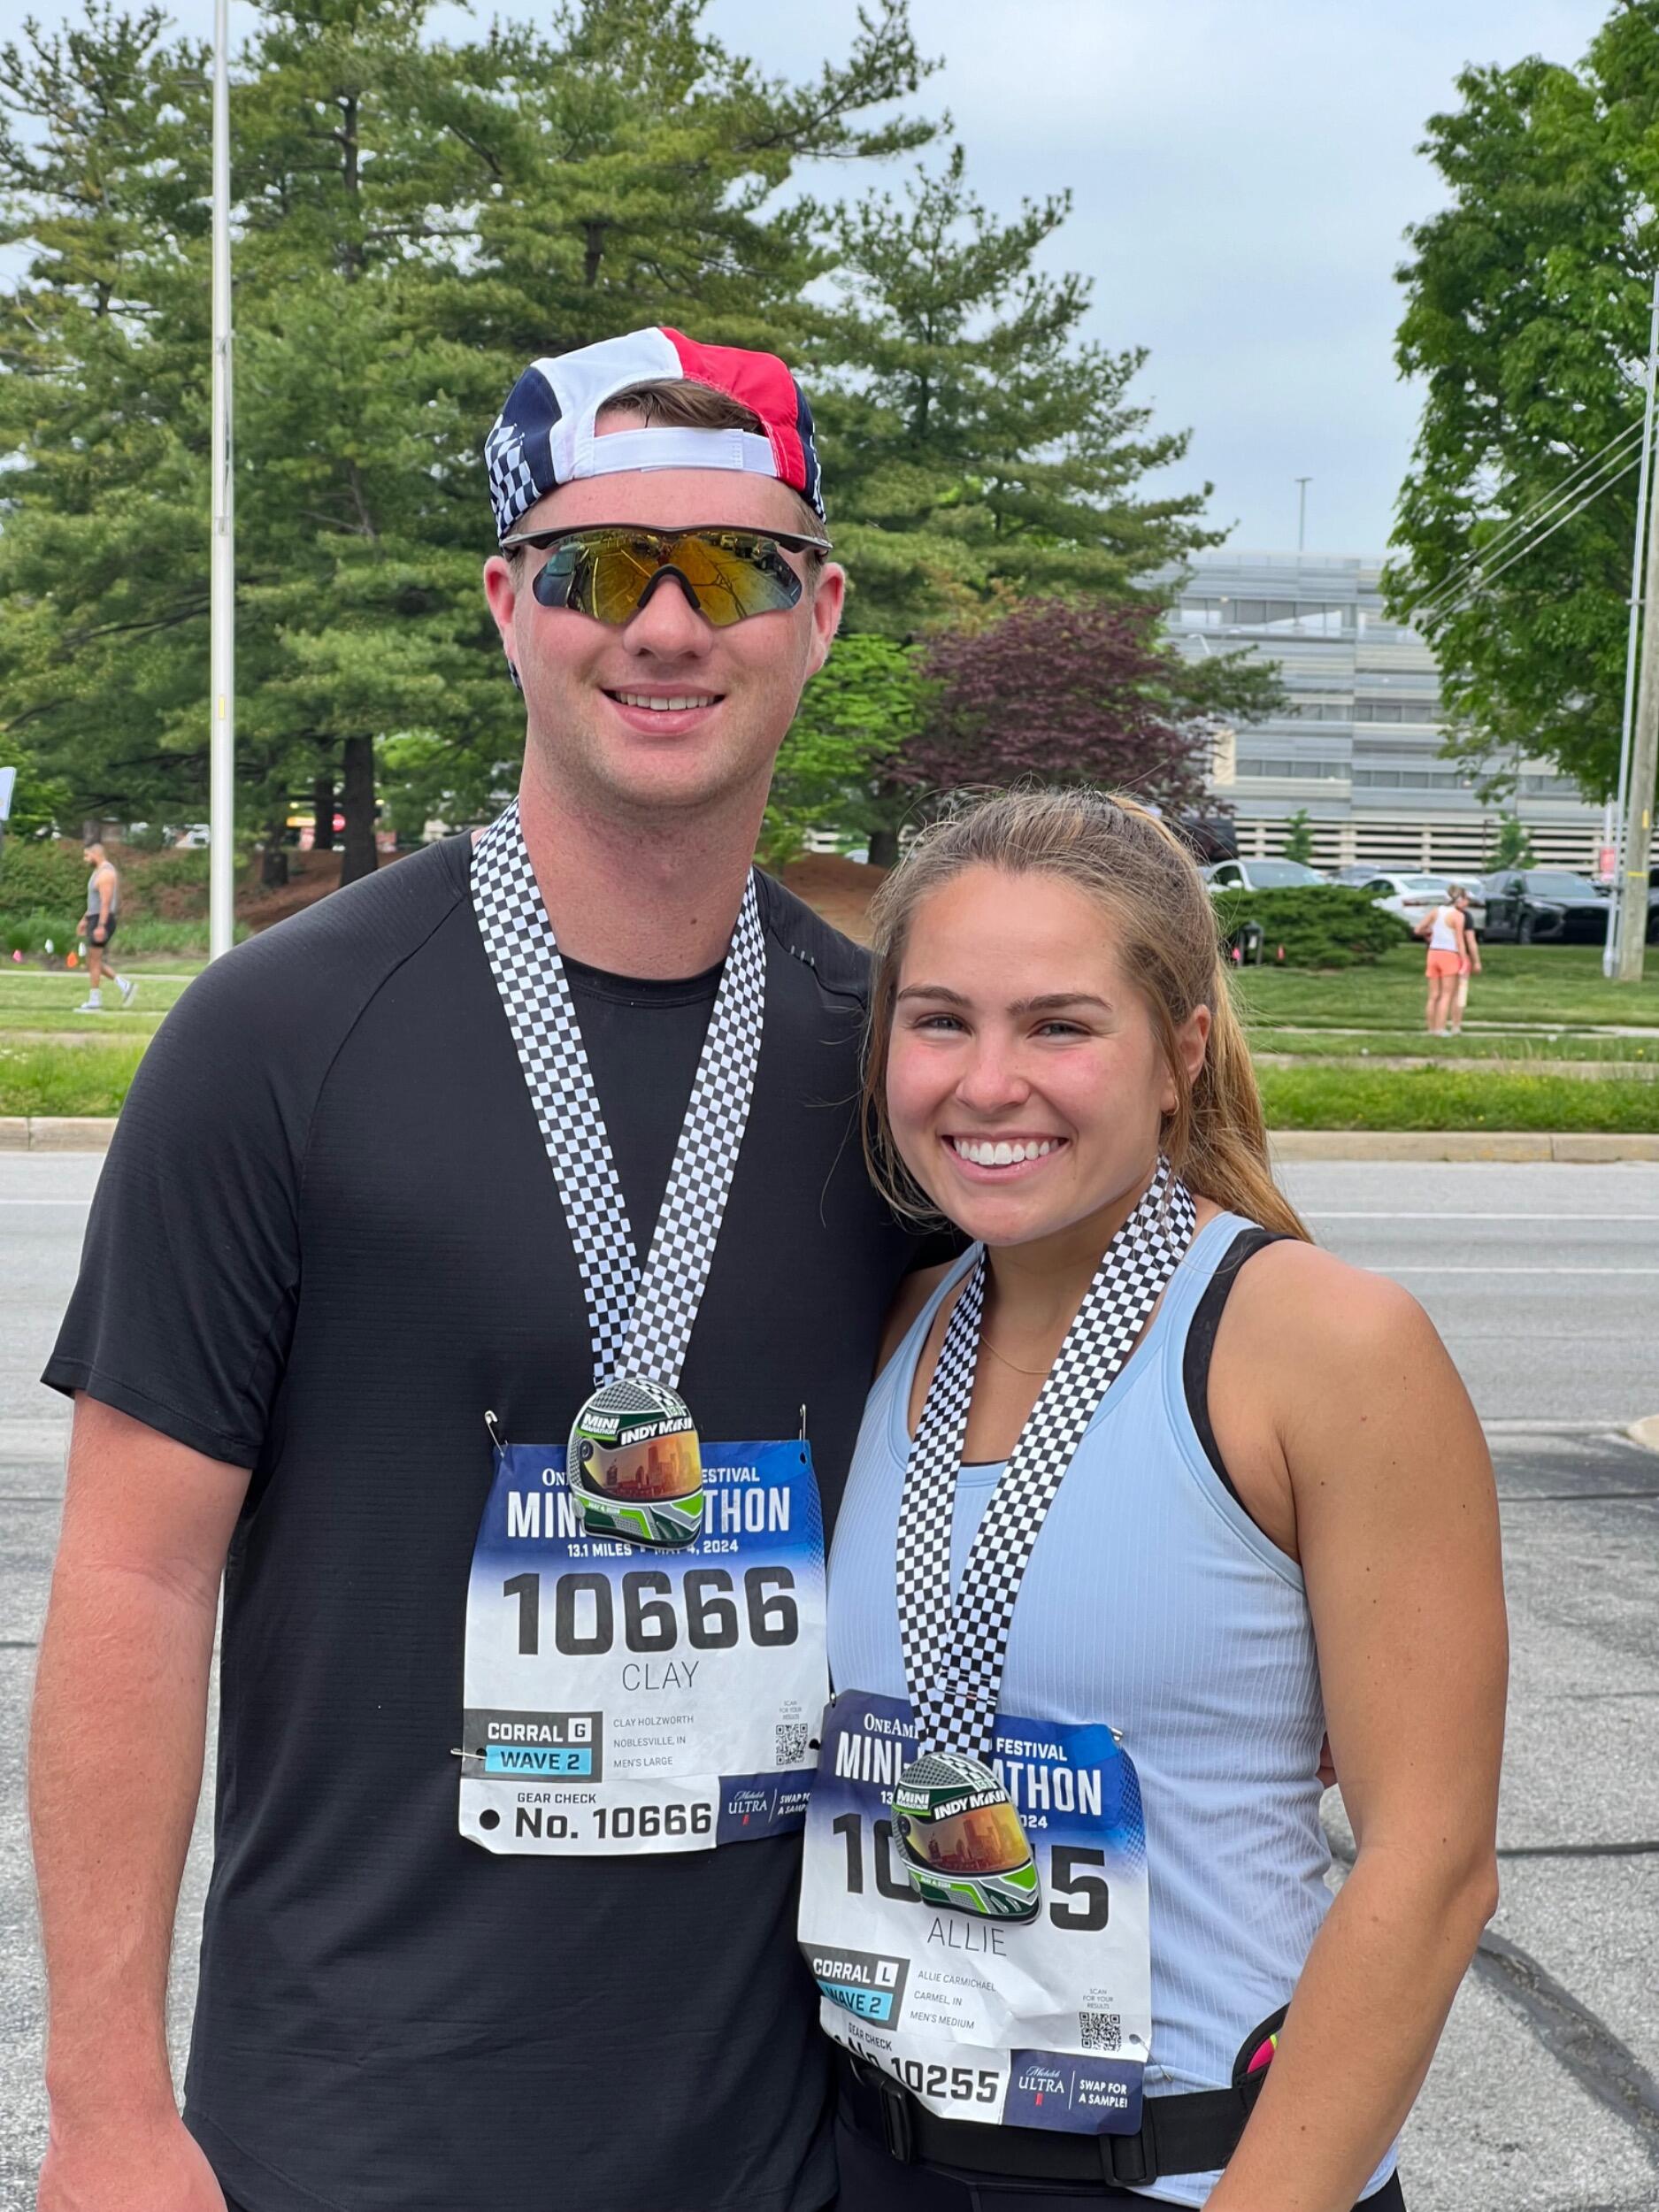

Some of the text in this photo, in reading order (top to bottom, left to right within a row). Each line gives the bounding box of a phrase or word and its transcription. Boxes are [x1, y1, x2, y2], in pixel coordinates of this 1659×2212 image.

[584, 1413, 619, 1430] MINI
[620, 1417, 693, 1446] INDY MINI
[703, 1468, 760, 1483] ESTIVAL
[567, 1544, 589, 1557] 13.1
[593, 1543, 633, 1557] MILES
[703, 1540, 739, 1554] 2024
[503, 1565, 798, 1656] 10666
[622, 1660, 699, 1691] CLAY
[612, 1715, 695, 1728] CLAY HOLZWORTH
[488, 1723, 586, 1742] CORRAL G
[613, 1736, 687, 1748] NOBLESVILLE, IN
[996, 1737, 1068, 1763] FESTIVAL
[500, 1752, 580, 1770] WAVE 2
[613, 1756, 673, 1769] MEN'S LARGE
[517, 1793, 596, 1804] GEAR CHECK
[780, 1793, 802, 1804] SWAP
[896, 1788, 930, 1804] MINI
[933, 1789, 1006, 1821] INDY MINI
[728, 1800, 767, 1814] ULTRA
[515, 1803, 711, 1839] No. 10666
[927, 1916, 1007, 1957] ALLIE
[813, 1958, 891, 1984] CORRAL L
[918, 1970, 996, 1992] ALLIE CARMICHAEL
[825, 1986, 882, 2014] WAVE 2
[914, 1990, 963, 2006] CARMEL, IN
[910, 2010, 975, 2029] MEN'S MEDIUM
[864, 2032, 892, 2051] CHECK
[891, 2057, 999, 2103] 10255
[1018, 2076, 1065, 2093] ULTRA
[1079, 2079, 1127, 2094] SWAP FOR
[1079, 2094, 1128, 2108] A SAMPLE!
